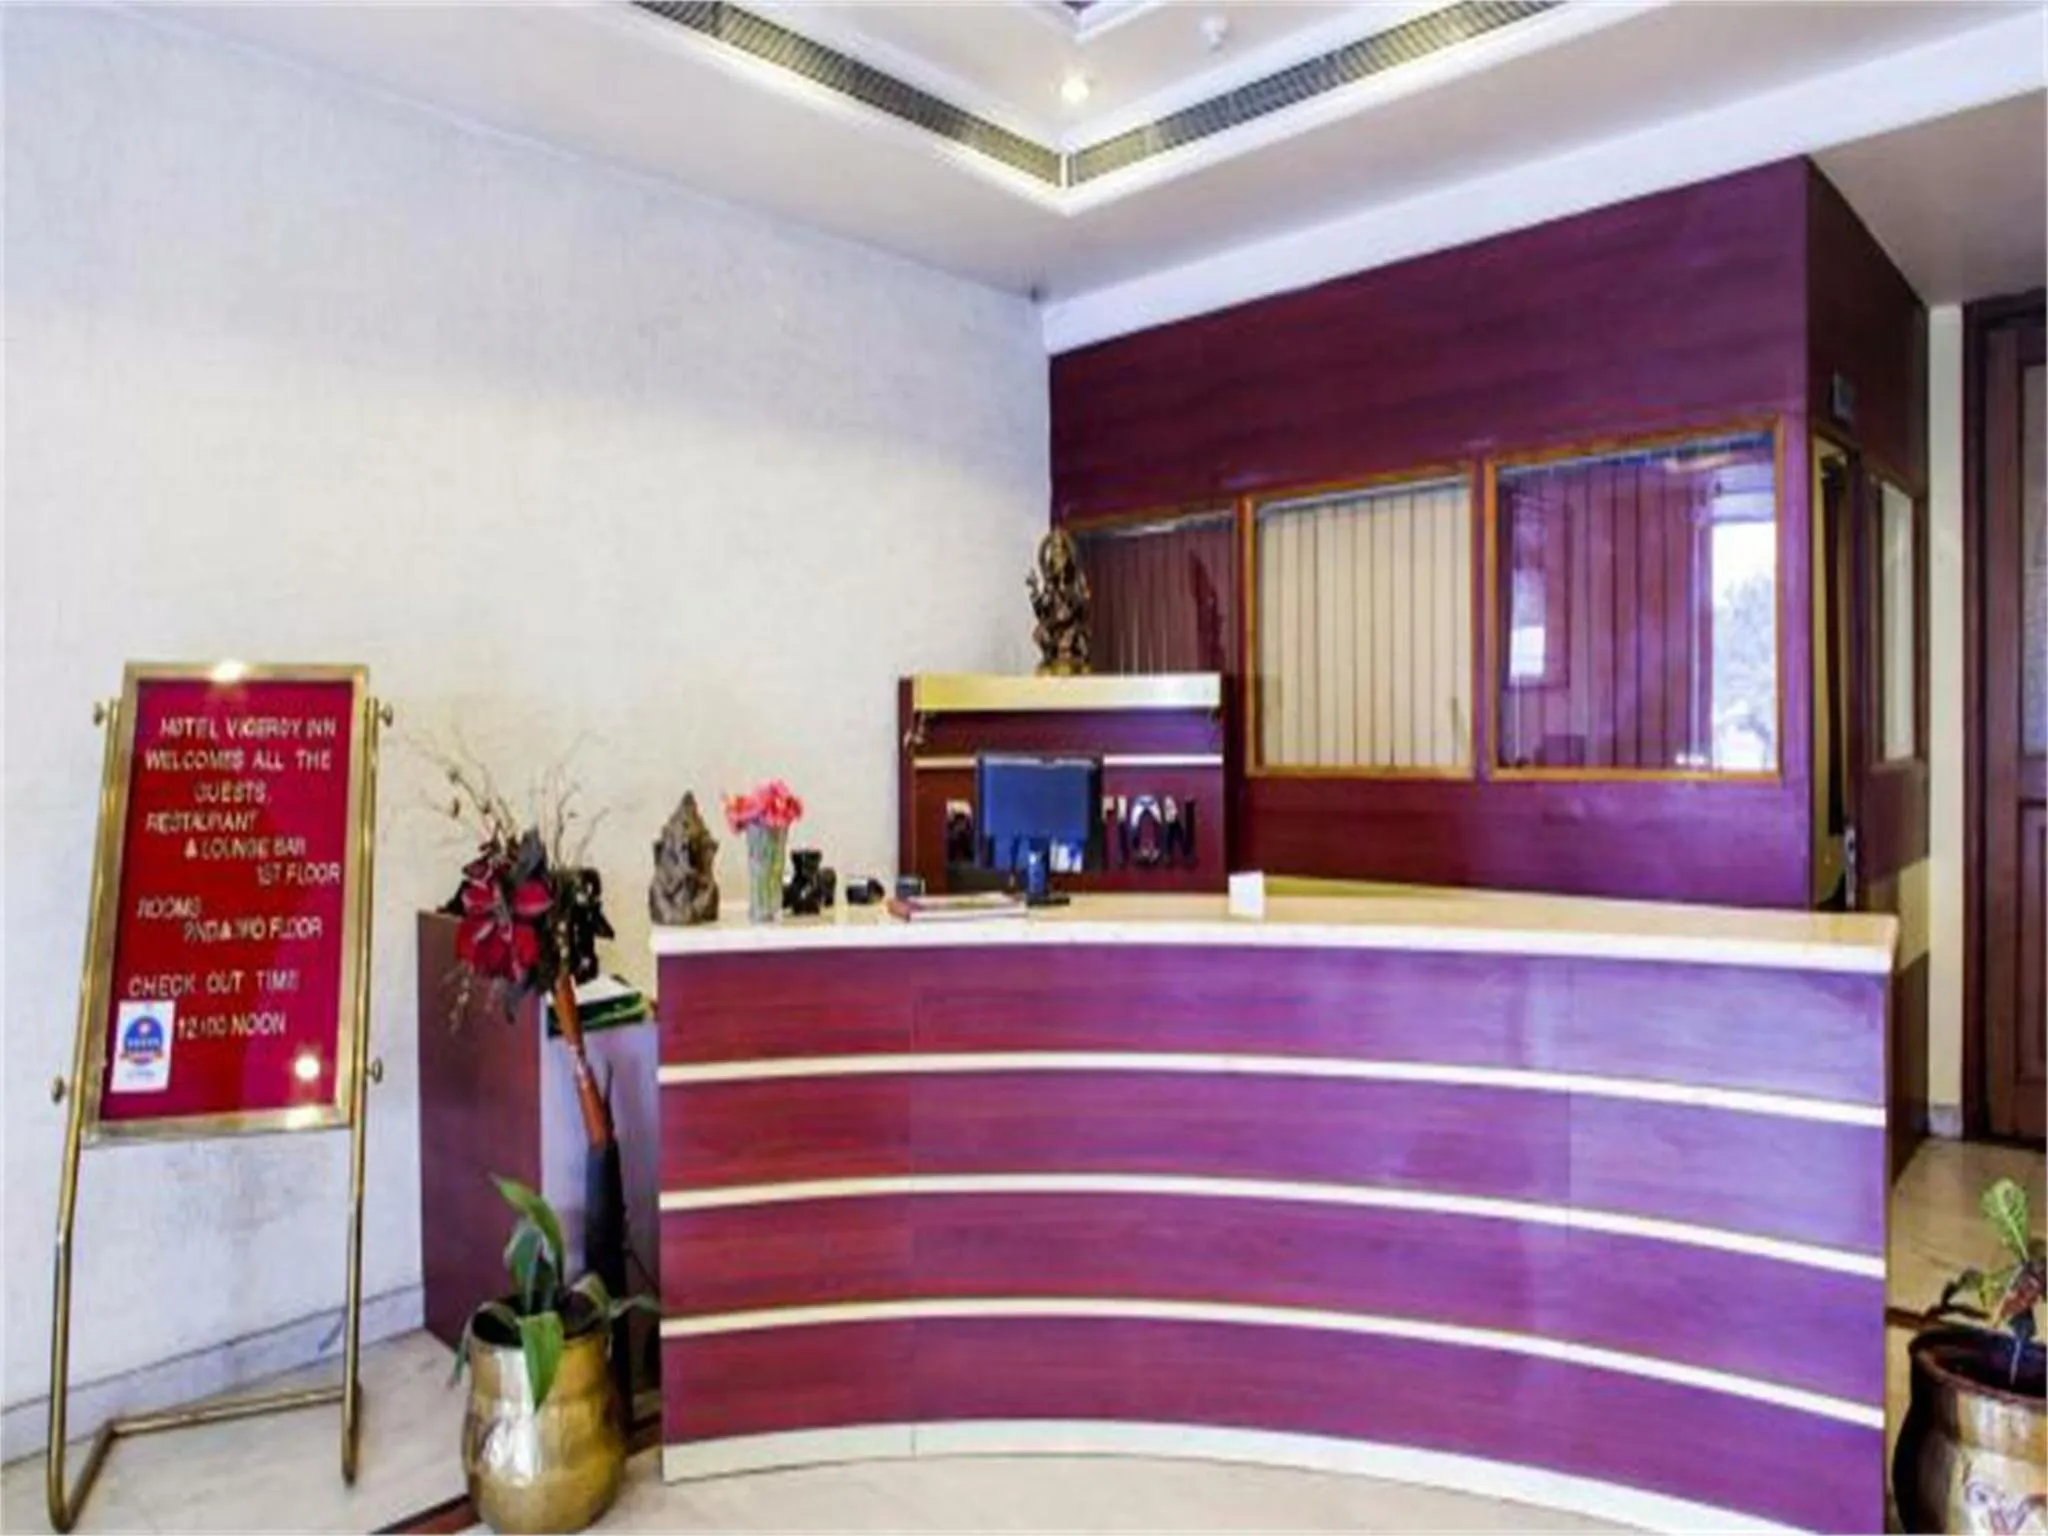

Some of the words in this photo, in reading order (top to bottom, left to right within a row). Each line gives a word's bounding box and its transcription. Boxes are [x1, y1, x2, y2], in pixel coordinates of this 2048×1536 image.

[252, 749, 284, 771] ALL
[295, 747, 332, 771] THE
[285, 861, 341, 886] FLOOR
[269, 914, 323, 940] FLOOR
[128, 972, 197, 998] CHECK
[206, 968, 246, 994] OUT
[256, 968, 301, 992] TIME
[231, 1010, 287, 1037] NOON
